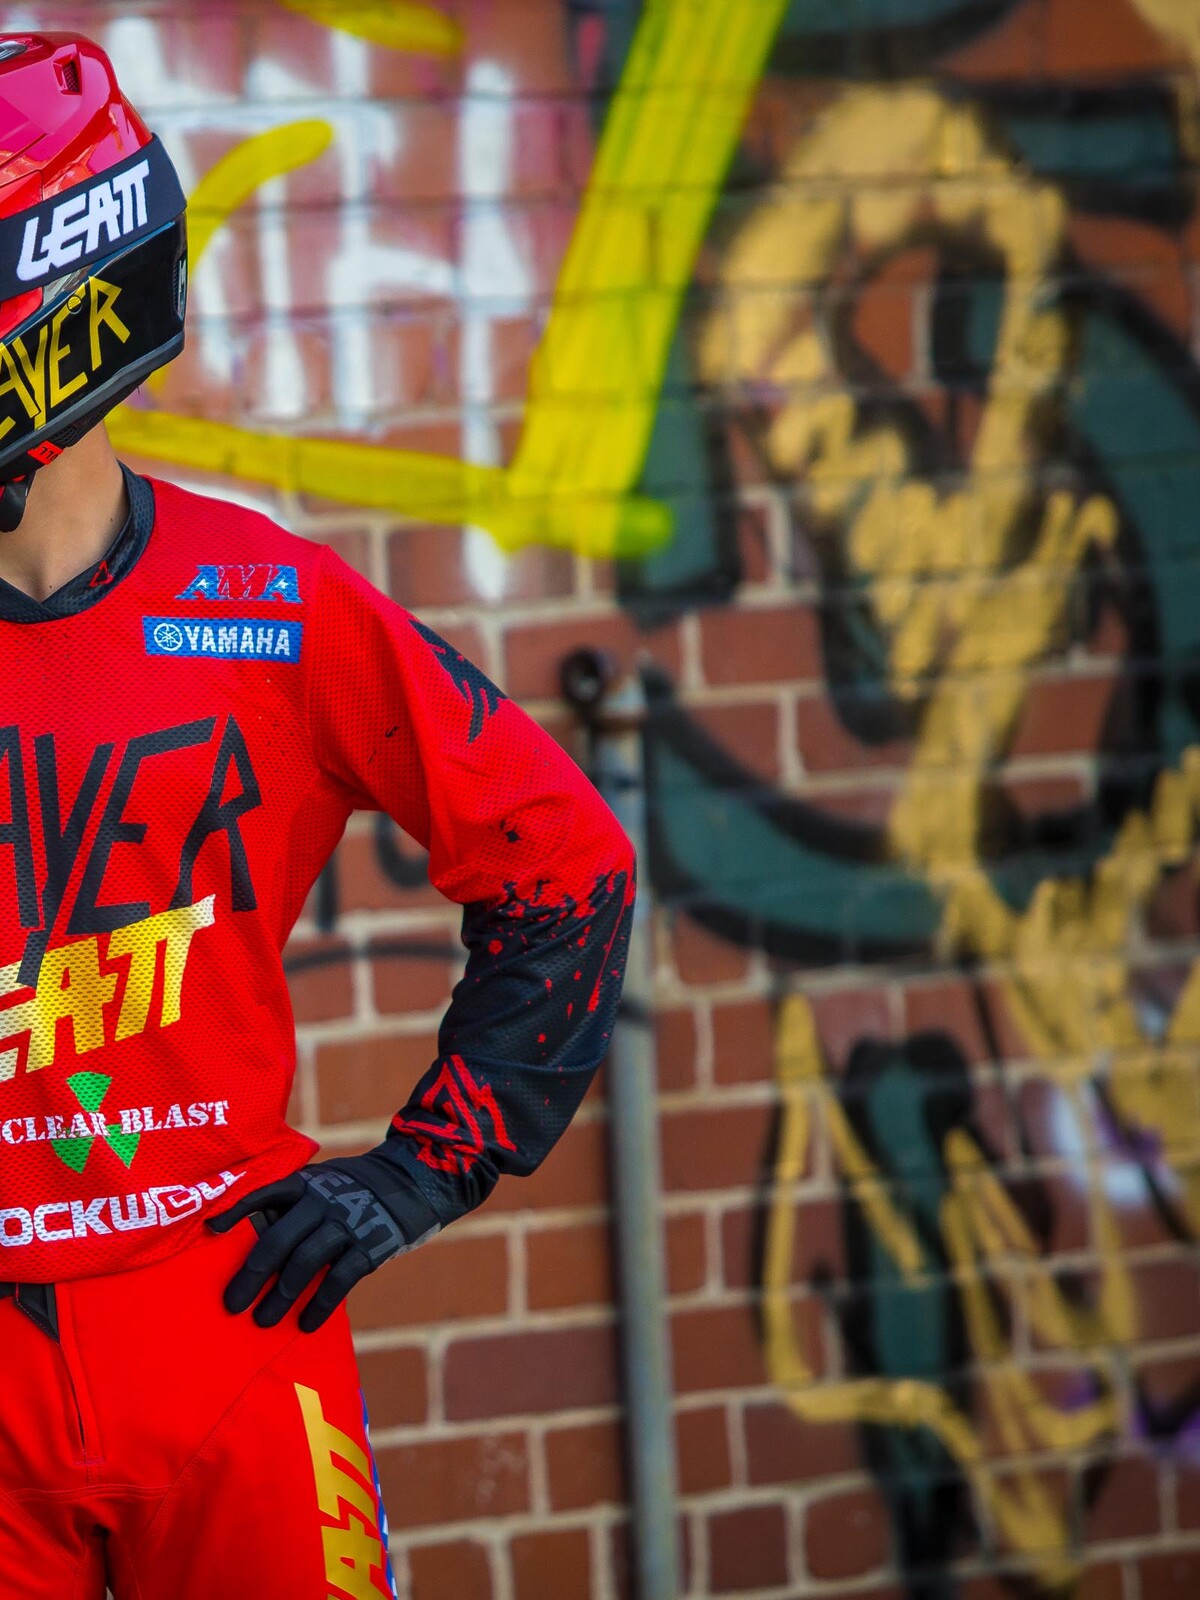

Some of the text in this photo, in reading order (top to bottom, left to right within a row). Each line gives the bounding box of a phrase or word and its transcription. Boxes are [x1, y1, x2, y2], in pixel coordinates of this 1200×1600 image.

[16, 158, 150, 282] LEATT
[174, 564, 303, 604] AMA
[184, 625, 291, 657] YAMAHA
[119, 1100, 230, 1136] BLAST
